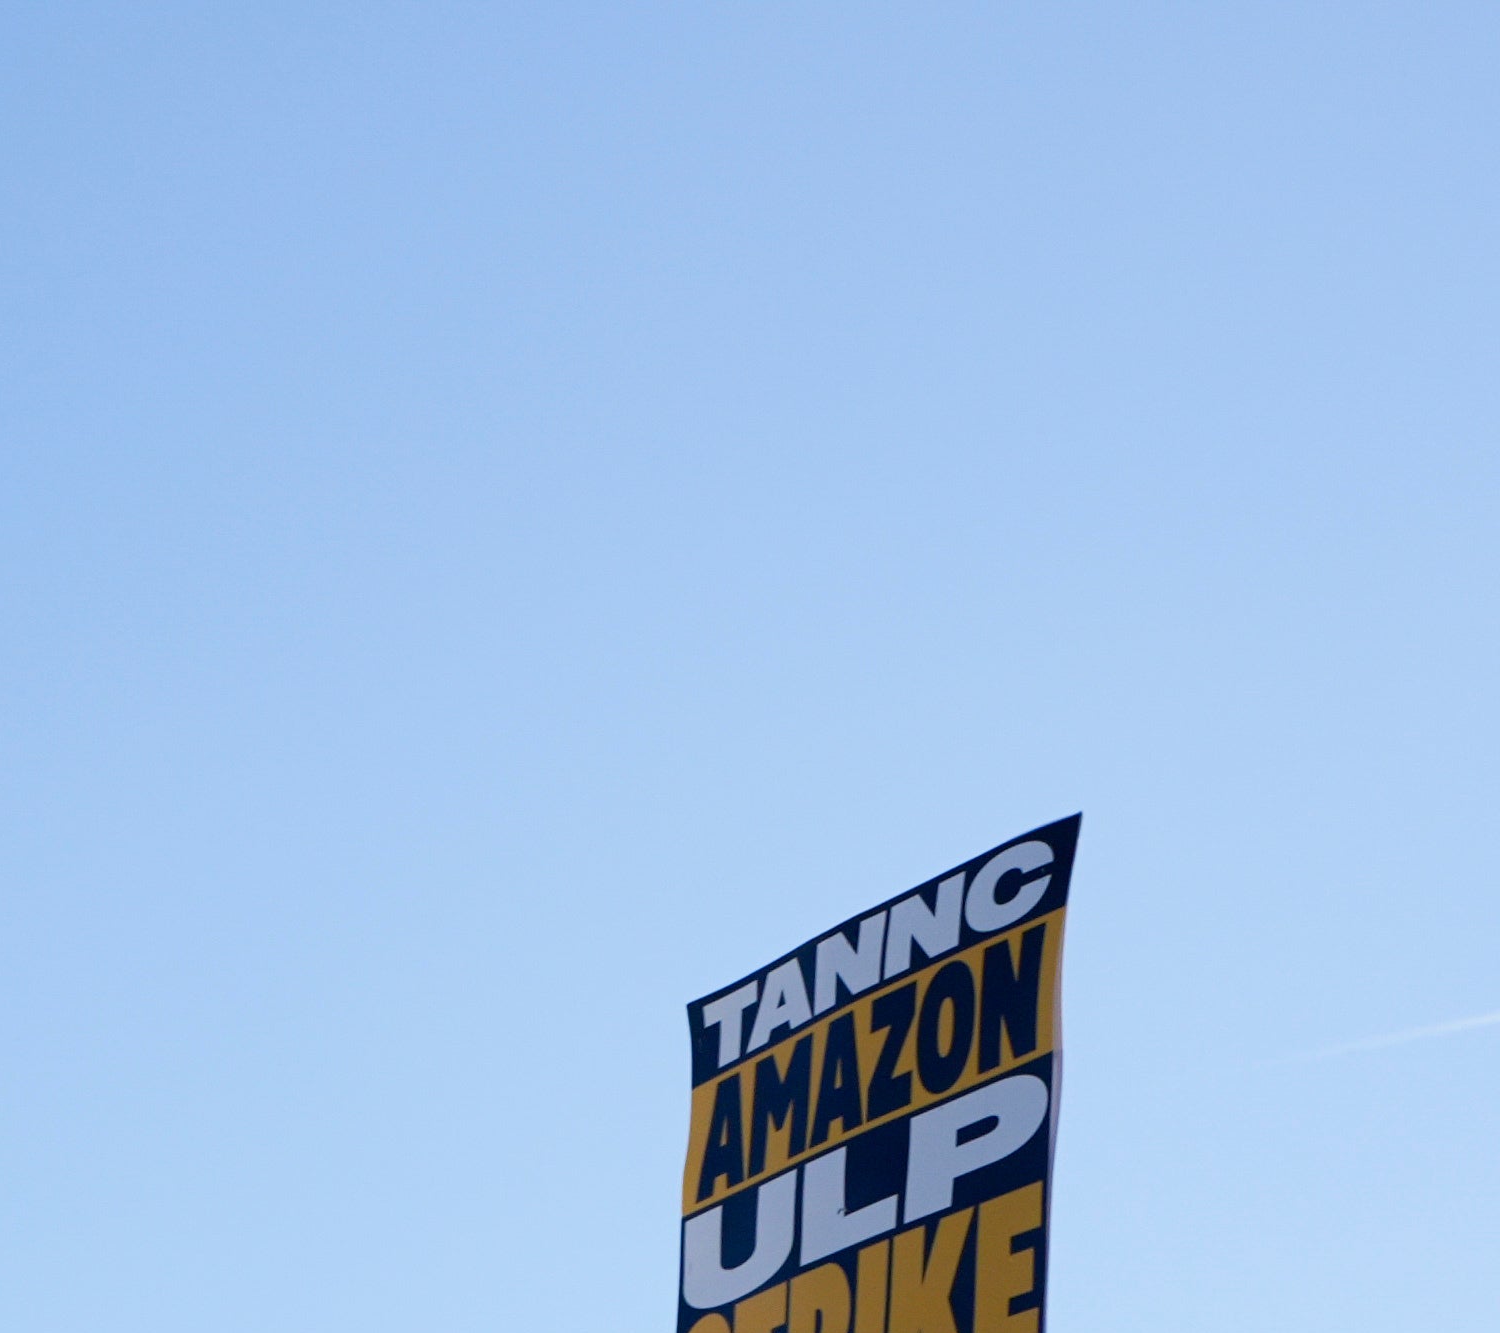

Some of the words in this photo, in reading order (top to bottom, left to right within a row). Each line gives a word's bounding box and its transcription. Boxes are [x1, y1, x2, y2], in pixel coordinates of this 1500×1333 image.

[696, 922, 1047, 1204] AMAZON
[701, 840, 1055, 1069] TANNC
[683, 1074, 1049, 1311] ULP
